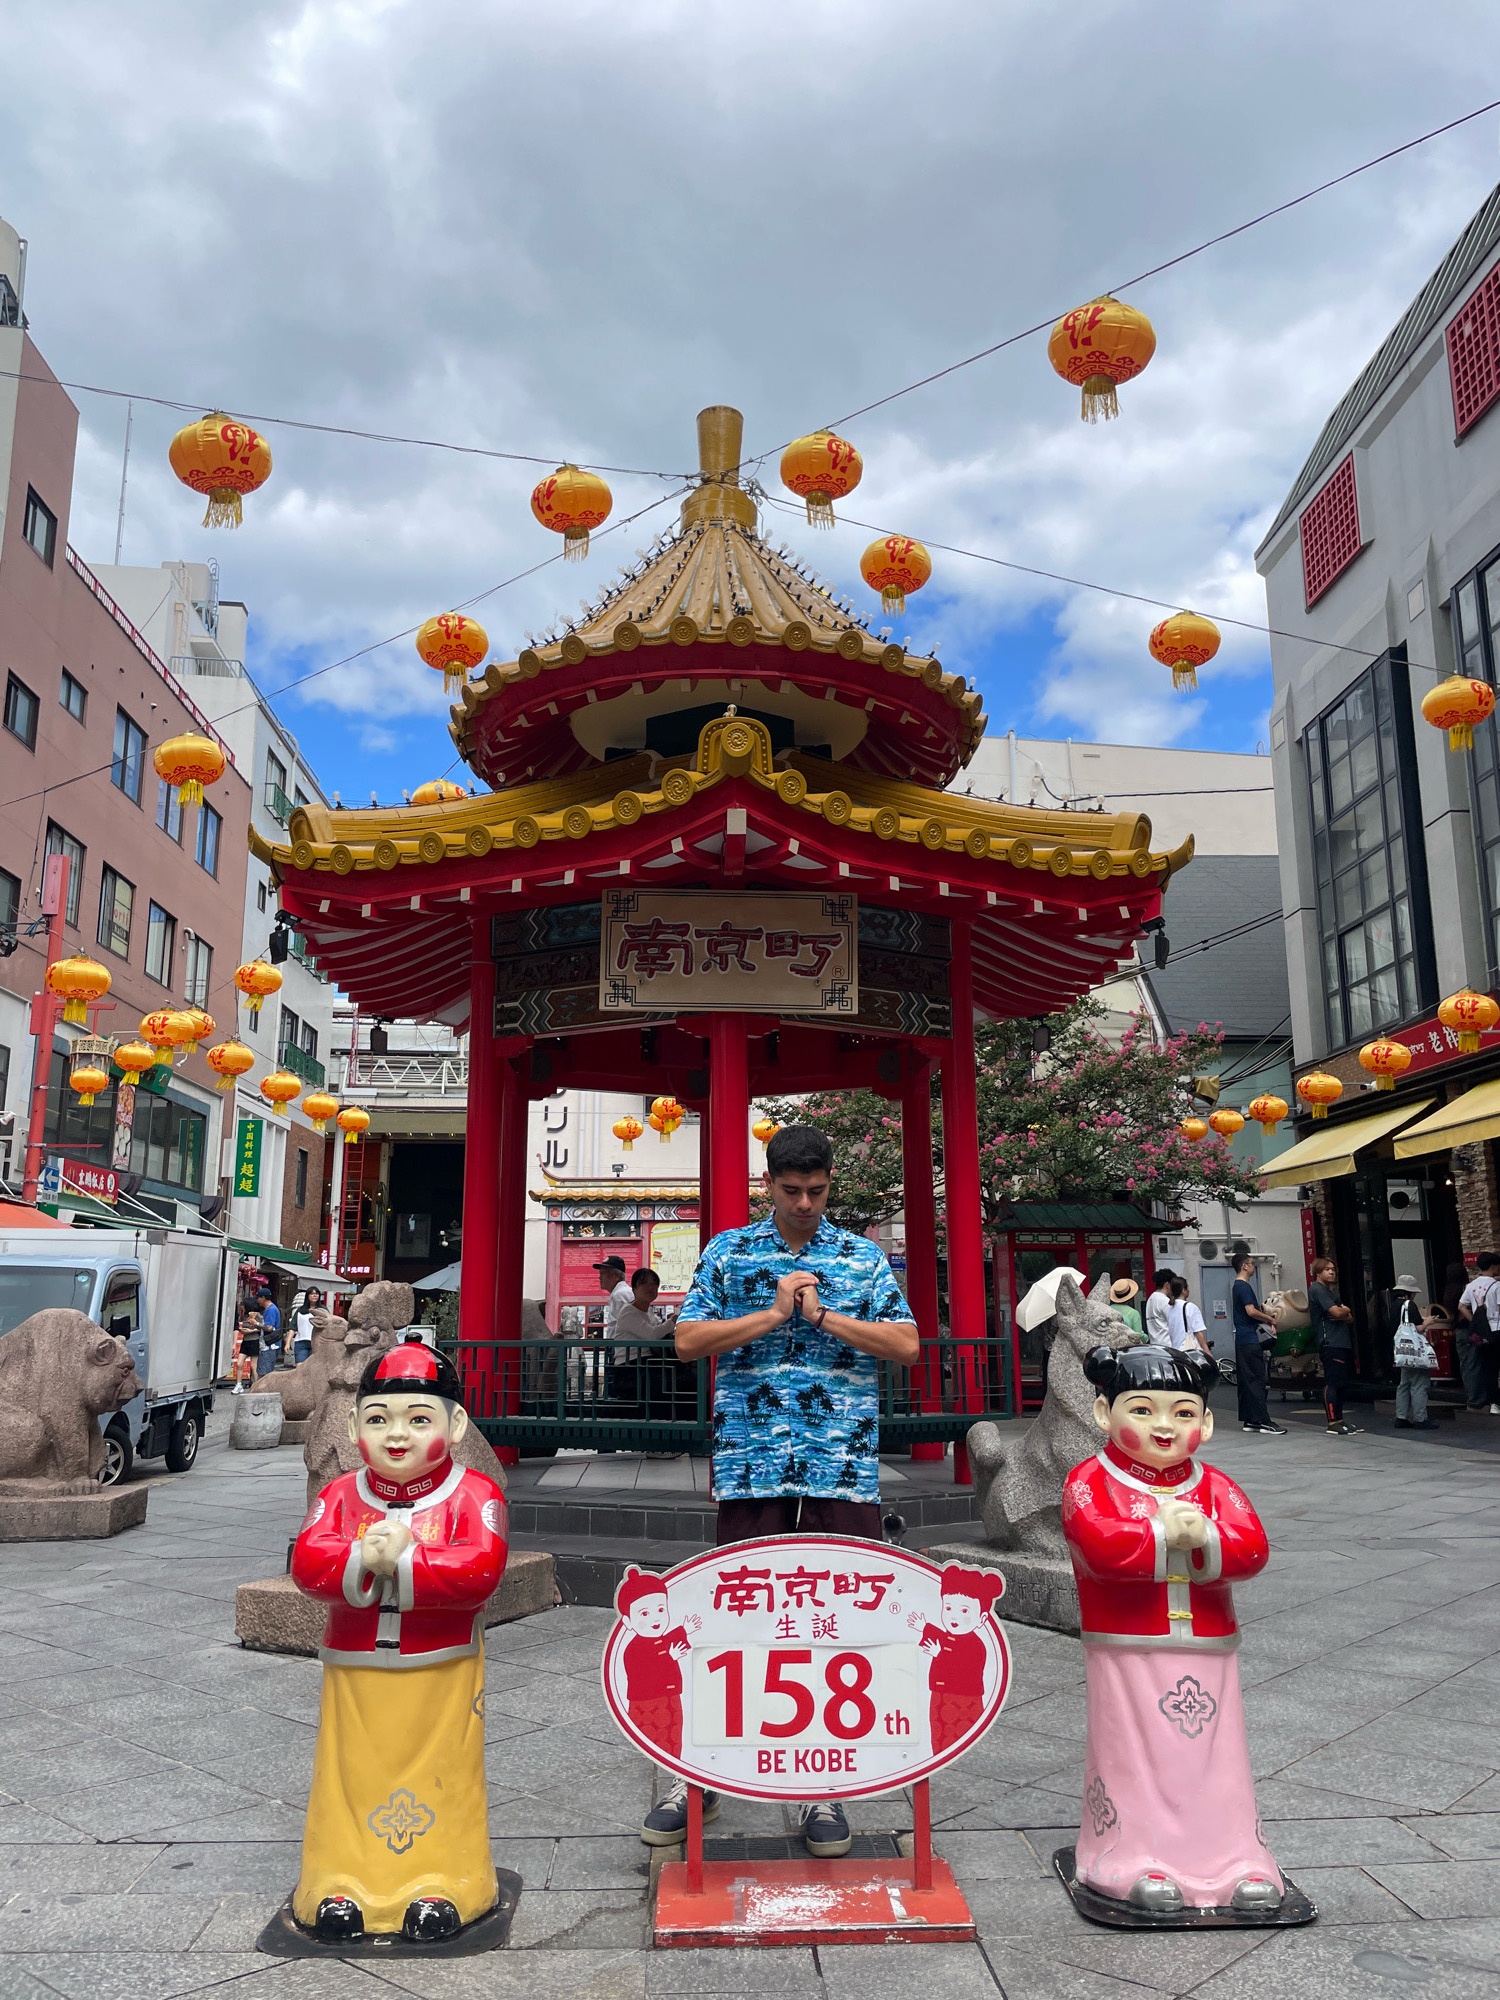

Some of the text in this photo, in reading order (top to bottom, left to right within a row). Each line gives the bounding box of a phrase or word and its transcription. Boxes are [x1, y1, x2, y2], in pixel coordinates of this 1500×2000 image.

[617, 917, 843, 979] 南京町
[1407, 1043, 1425, 1056] 京町
[539, 1088, 568, 1168] リル
[238, 1162, 255, 1193] 超超
[421, 1523, 440, 1542] 財
[713, 1564, 896, 1618] 南京町
[774, 1612, 840, 1640] 生誕
[757, 1747, 858, 1774] BE KOBE
